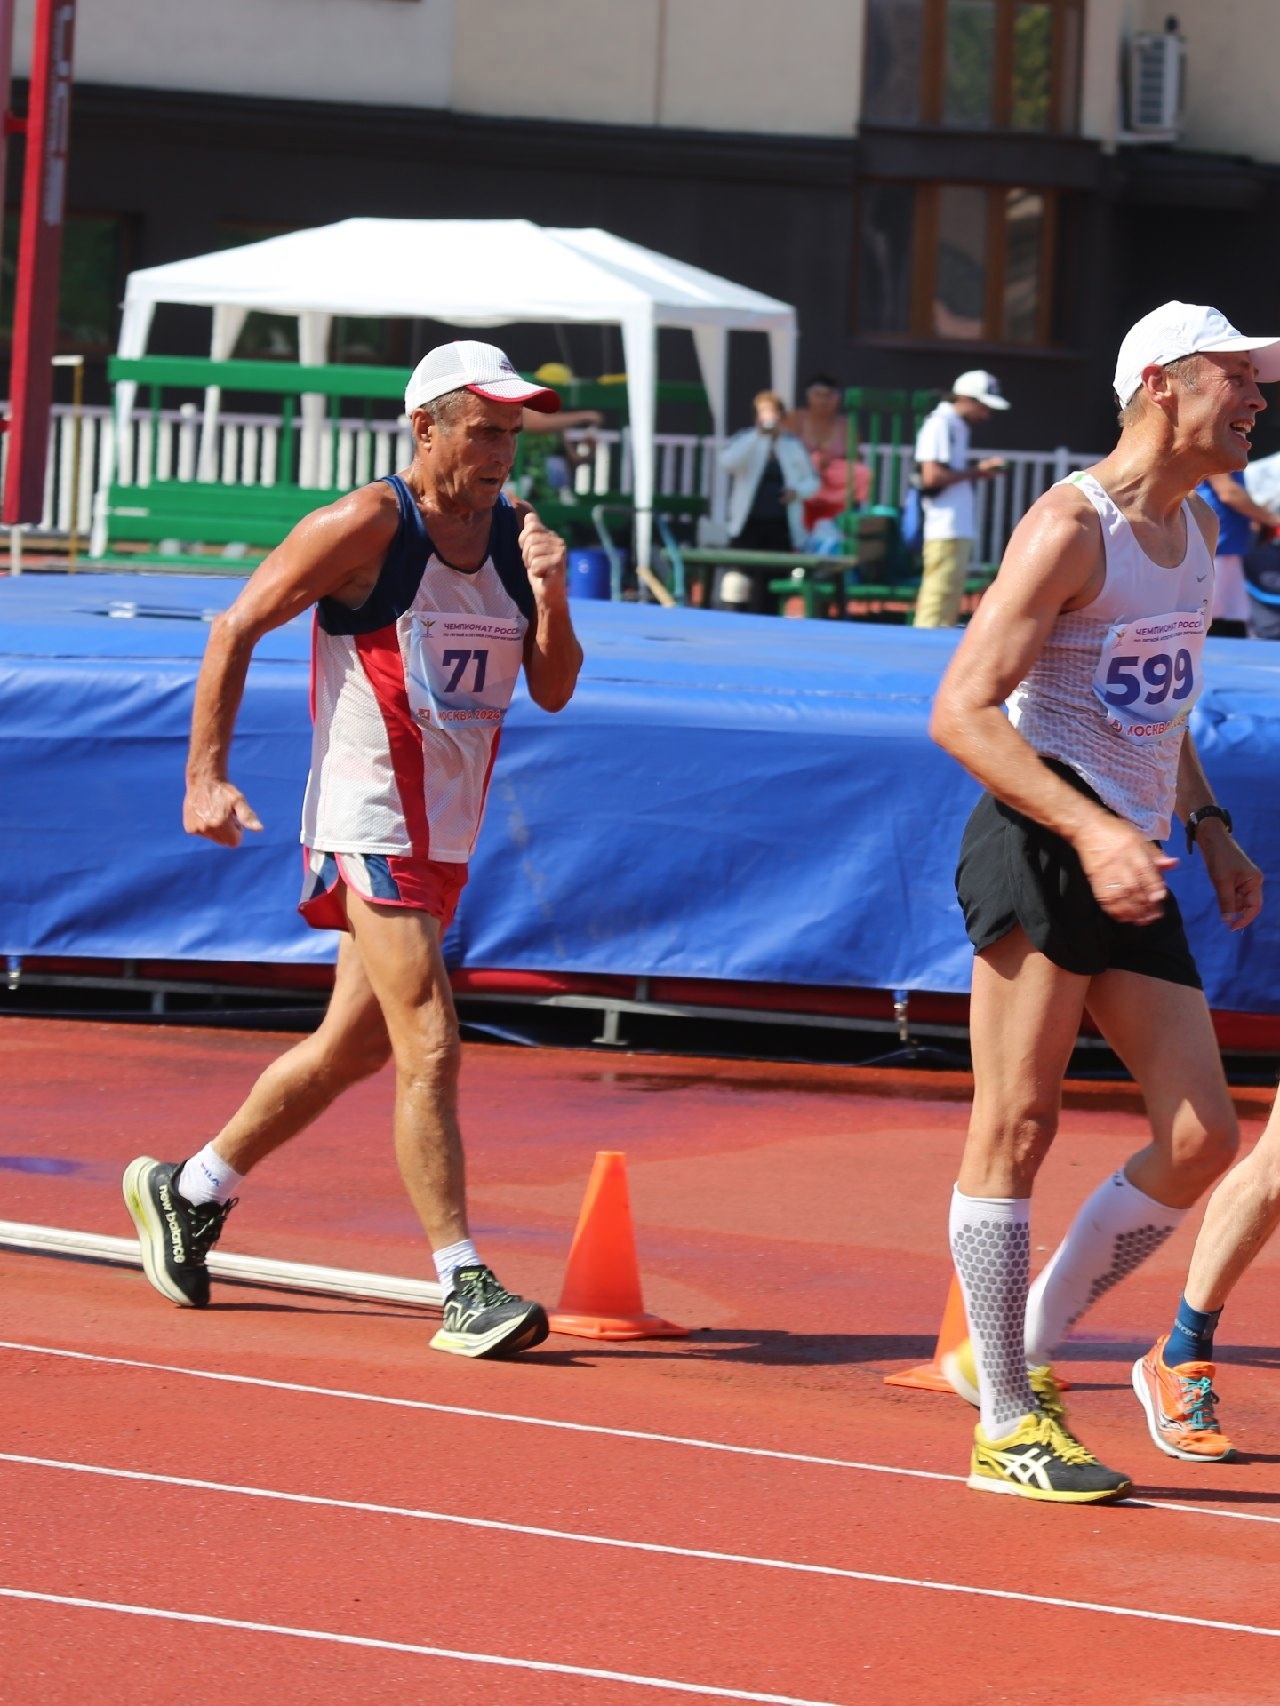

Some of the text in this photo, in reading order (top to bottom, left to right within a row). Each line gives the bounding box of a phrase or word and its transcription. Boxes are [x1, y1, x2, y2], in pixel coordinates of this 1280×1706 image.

[443, 623, 493, 633] ЧЕМПИОНАТ
[442, 649, 489, 693] 71
[1104, 648, 1194, 707] 599
[159, 1184, 186, 1264] new balance
